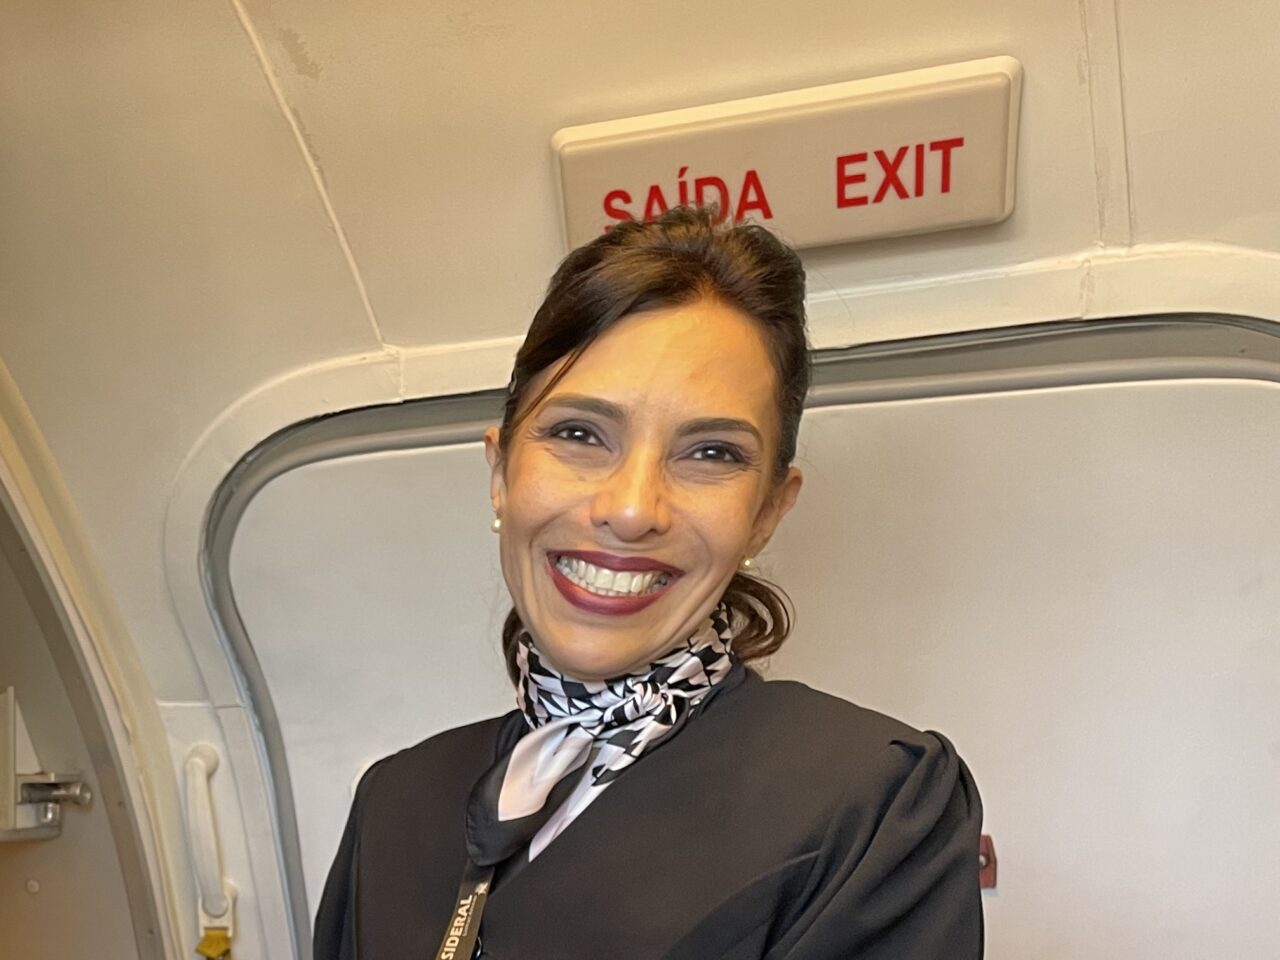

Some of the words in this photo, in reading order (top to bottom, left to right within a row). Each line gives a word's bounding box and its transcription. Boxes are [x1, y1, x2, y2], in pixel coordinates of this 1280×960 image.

[603, 167, 773, 233] SAÍDA
[836, 137, 965, 209] EXIT
[441, 894, 473, 960] SIDERAL
